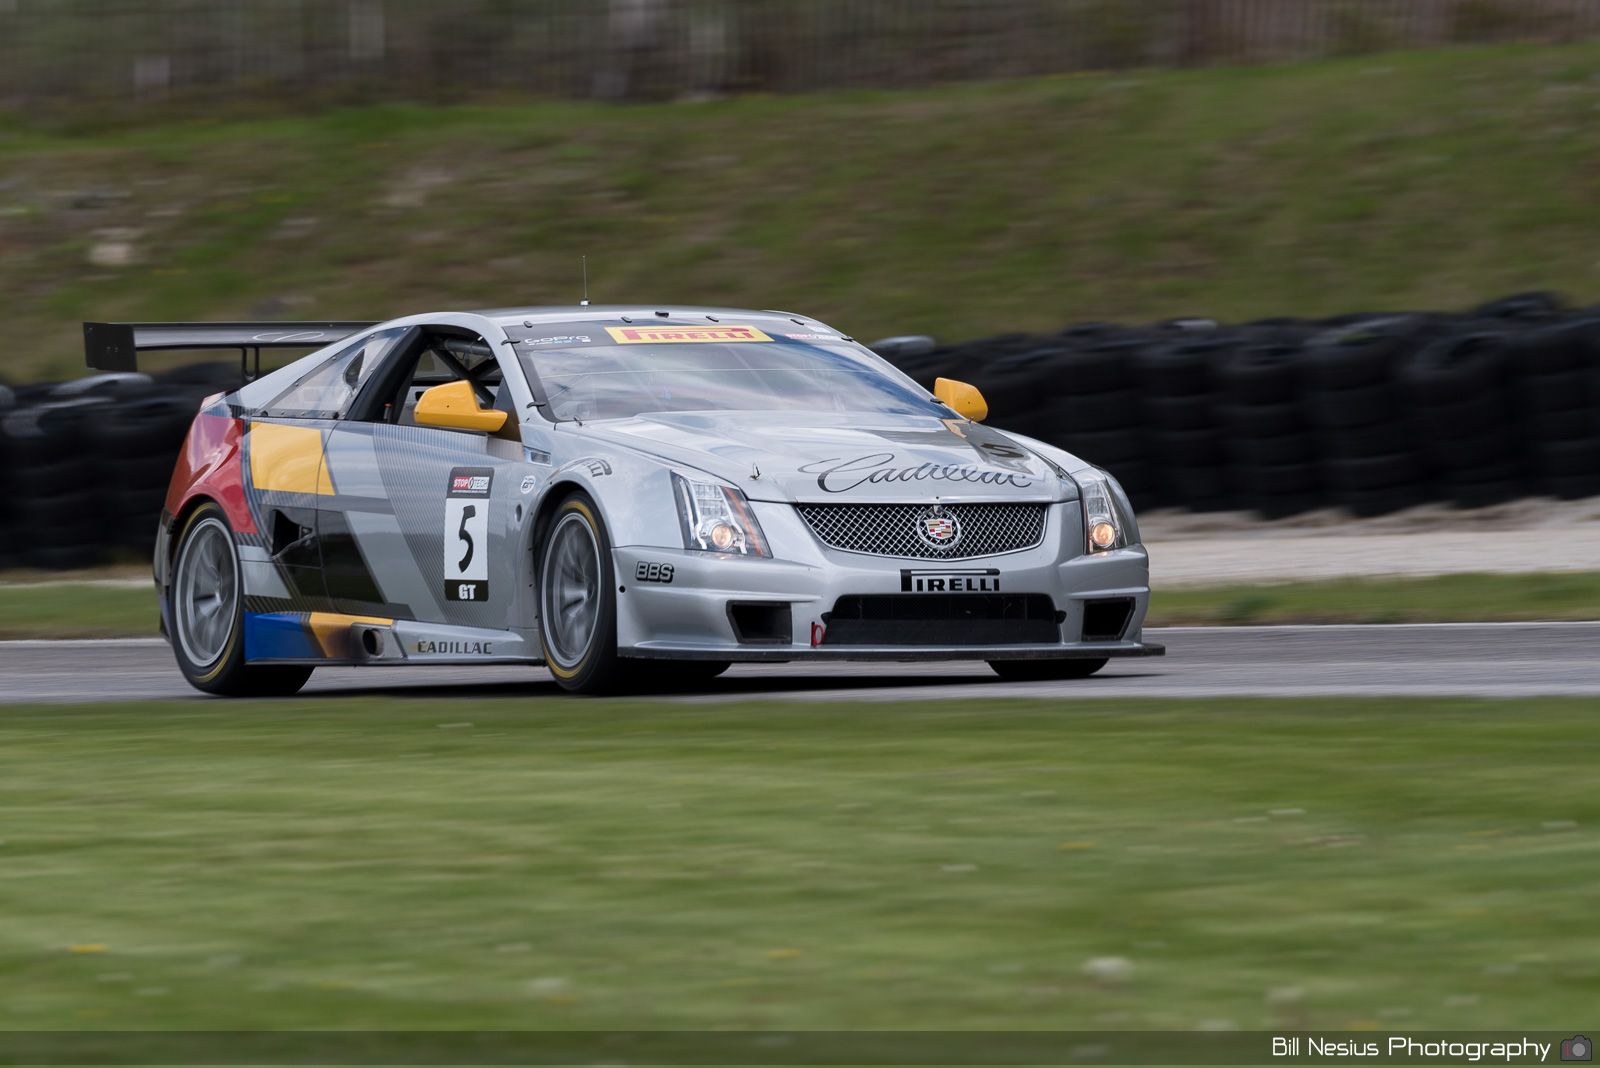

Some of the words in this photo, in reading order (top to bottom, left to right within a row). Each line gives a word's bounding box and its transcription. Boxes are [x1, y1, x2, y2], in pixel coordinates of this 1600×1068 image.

[620, 327, 755, 340] PIRELLI
[797, 453, 1032, 493] Cadillac
[458, 505, 476, 574] 5
[635, 561, 675, 584] BBS
[900, 568, 1000, 592] PIRELLI
[458, 584, 476, 600] GT
[417, 641, 493, 655] CADILLAC
